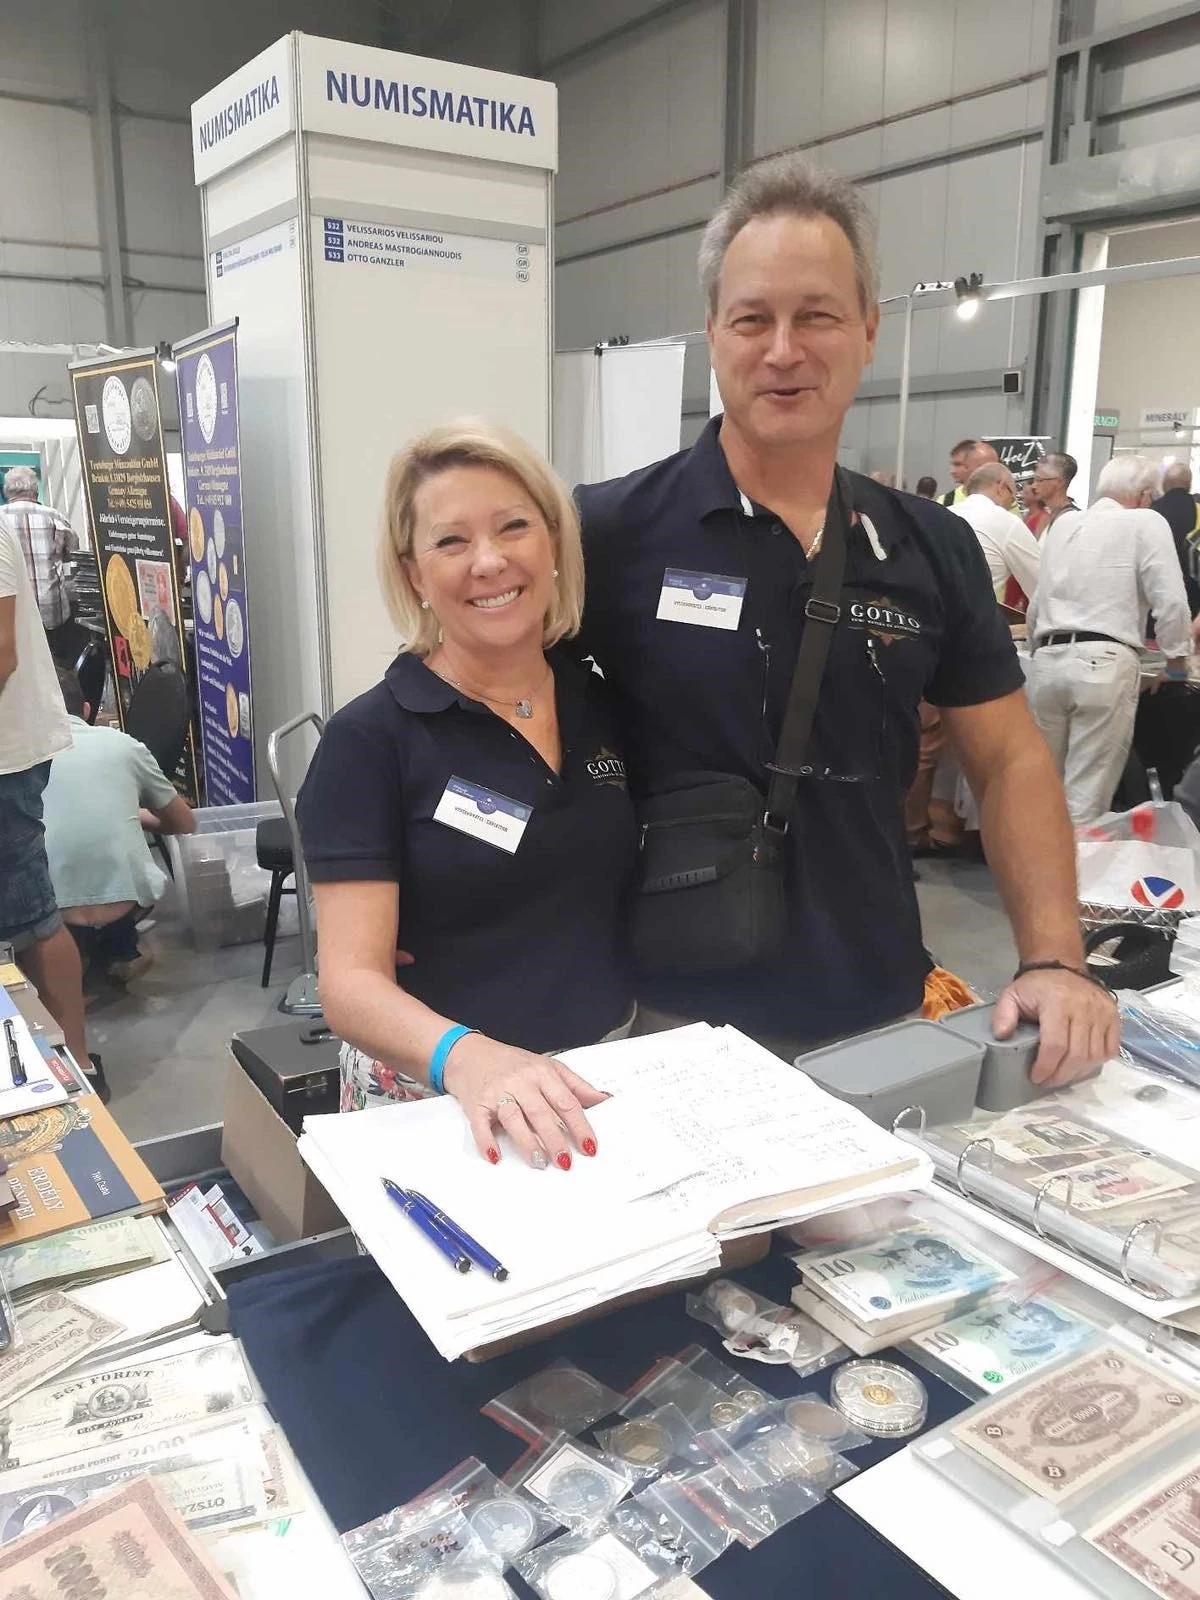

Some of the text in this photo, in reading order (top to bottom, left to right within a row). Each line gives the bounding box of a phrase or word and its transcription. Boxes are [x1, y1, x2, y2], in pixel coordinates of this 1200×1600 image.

[199, 75, 280, 151] NUMISMATIKA
[326, 70, 536, 136] NUMISMATIKA
[347, 225, 395, 237] VELISSARIOS
[396, 232, 443, 244] VELISSARIOU
[347, 240, 384, 251] ANDREAS
[347, 254, 368, 263] OTTO
[1145, 412, 1188, 423] MINERALY
[850, 604, 921, 629] GOTTO
[922, 1331, 960, 1354] 10
[52, 1369, 155, 1401] EGY FORINT
